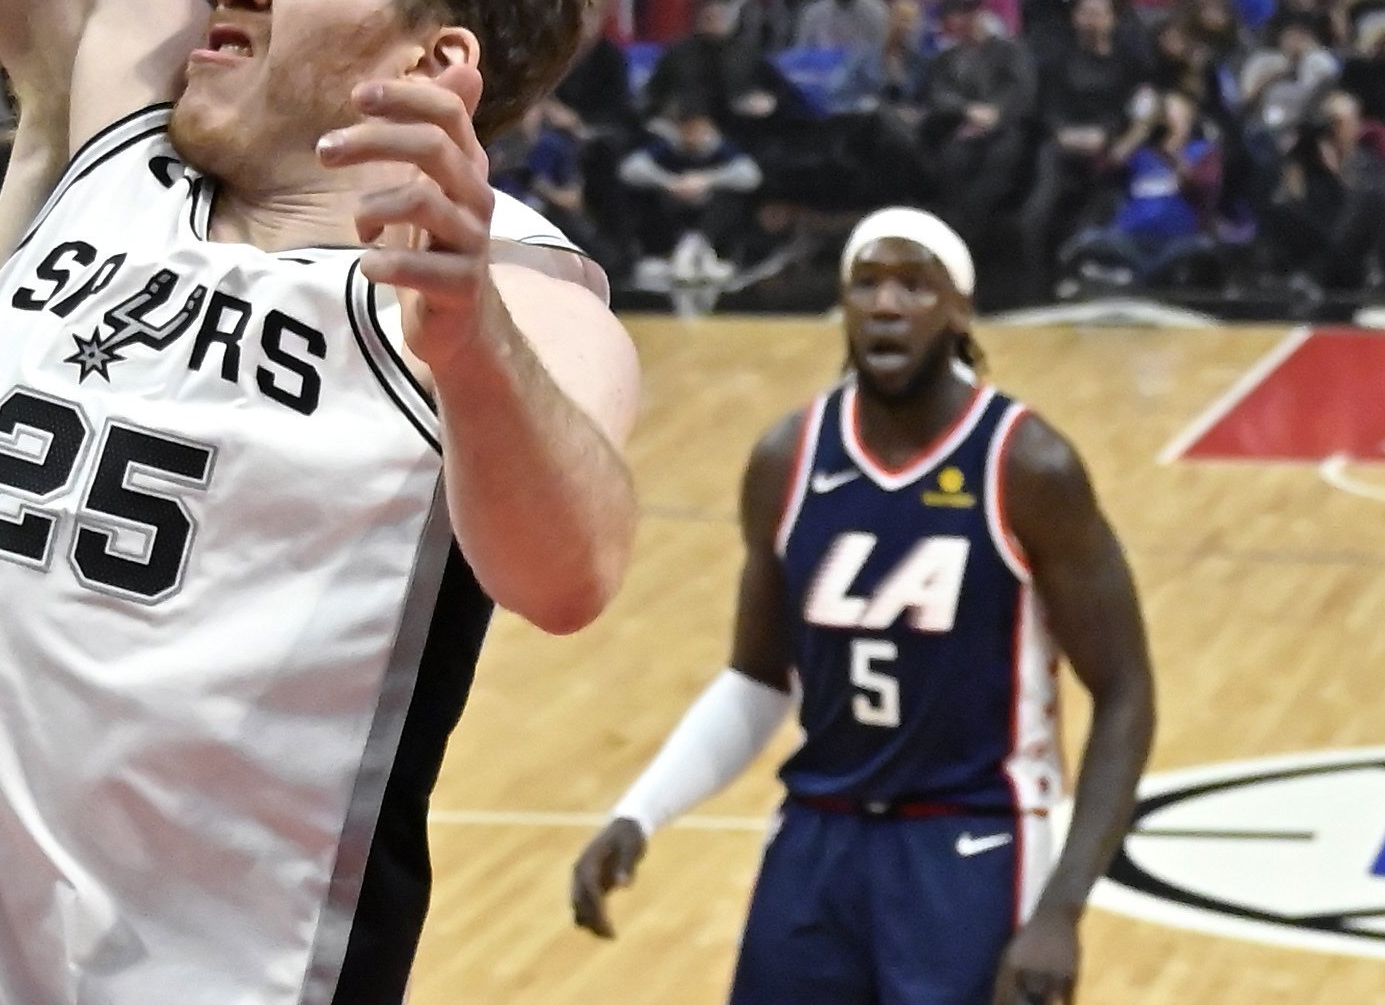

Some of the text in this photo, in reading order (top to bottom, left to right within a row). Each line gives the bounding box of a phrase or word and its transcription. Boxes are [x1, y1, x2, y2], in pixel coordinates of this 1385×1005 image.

[11, 240, 328, 416] SPURS
[803, 530, 972, 634] LA
[850, 636, 901, 728] 5
